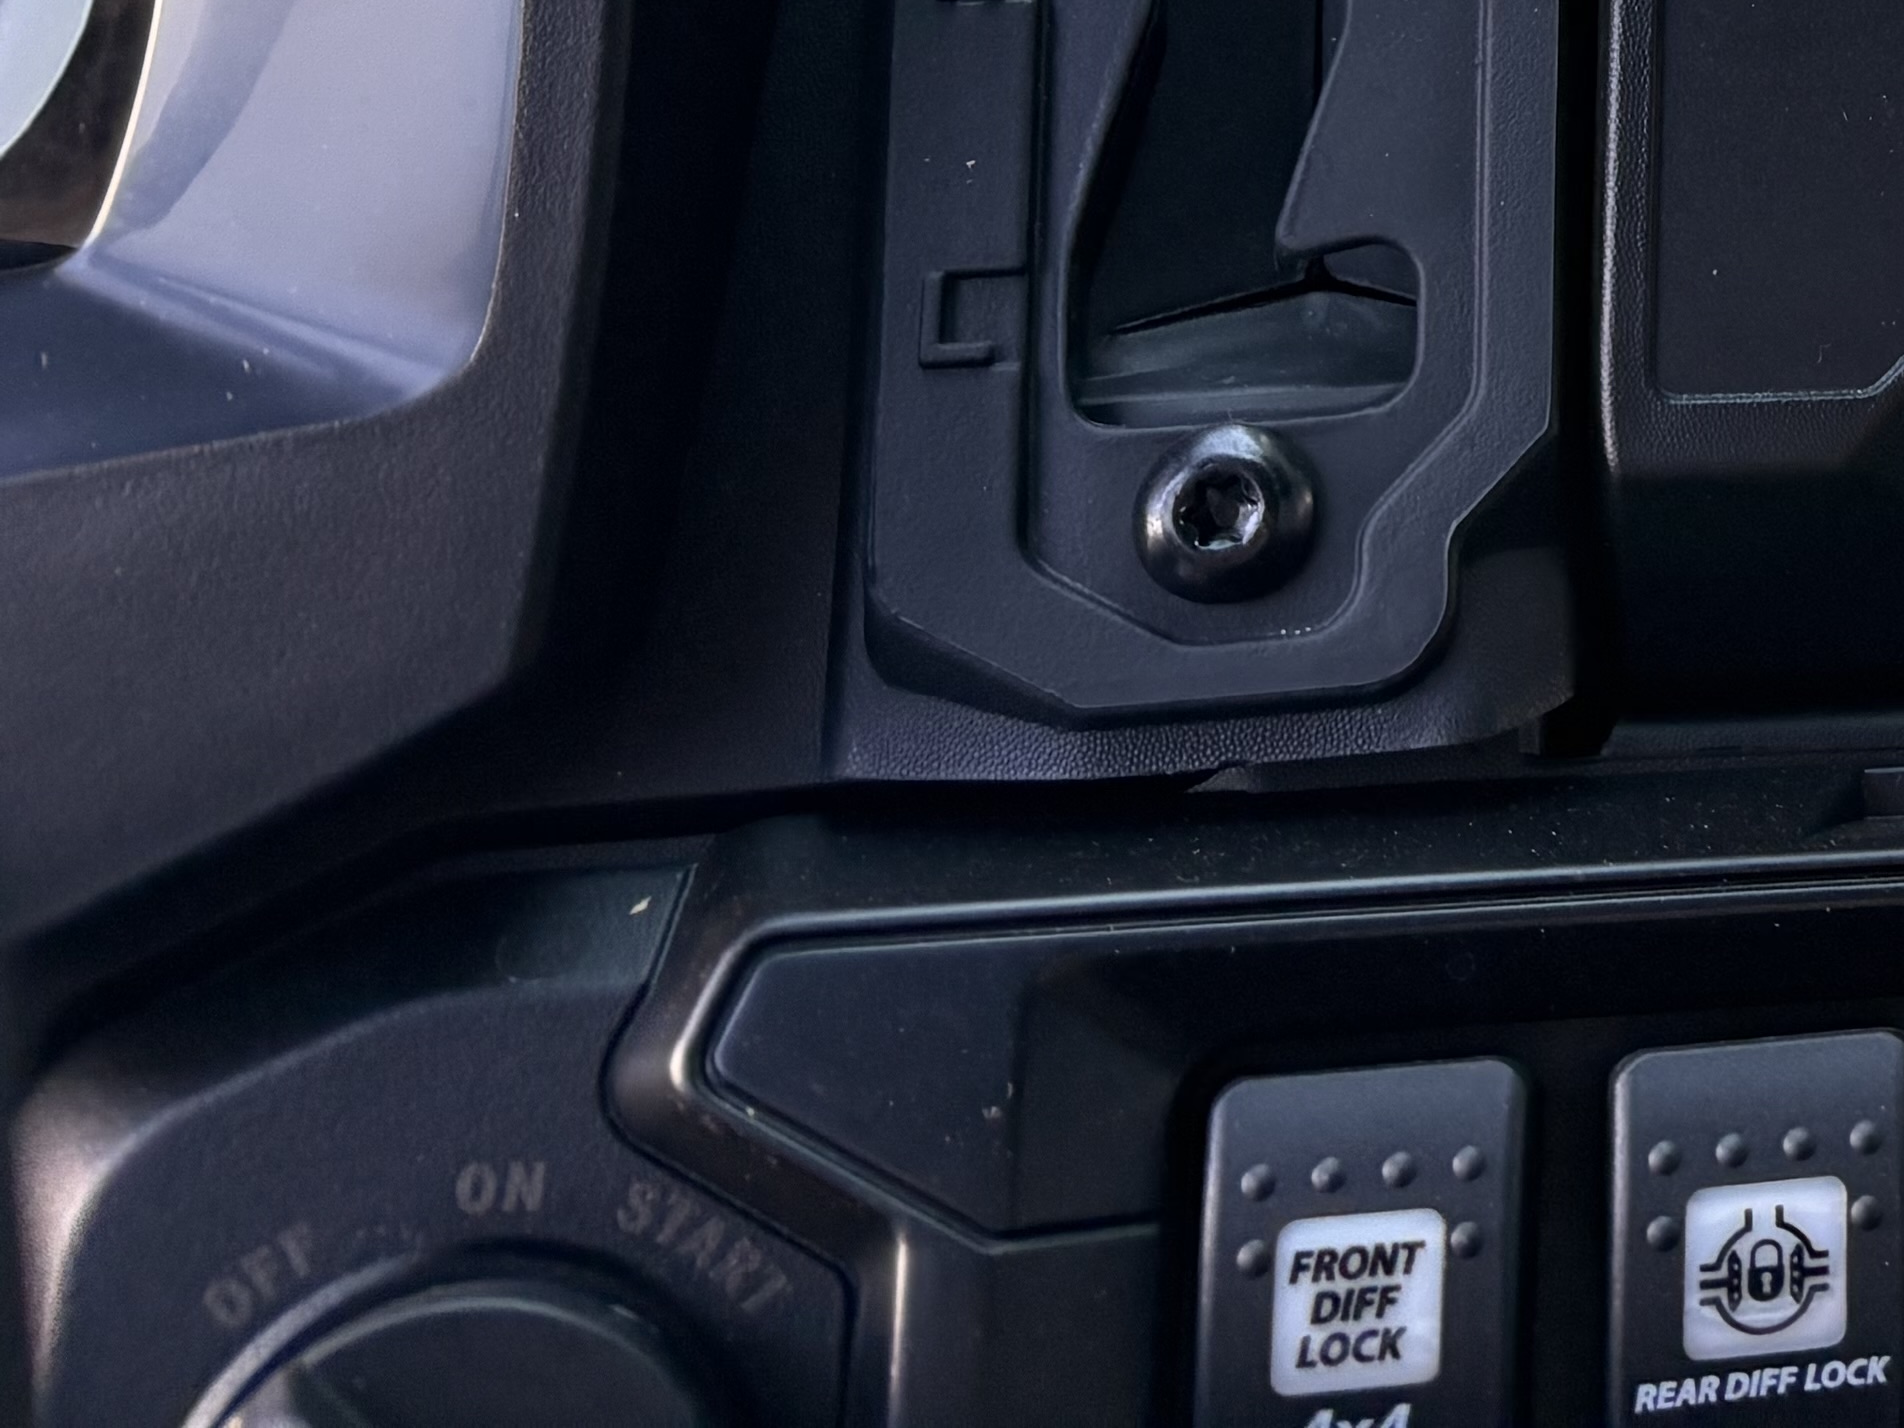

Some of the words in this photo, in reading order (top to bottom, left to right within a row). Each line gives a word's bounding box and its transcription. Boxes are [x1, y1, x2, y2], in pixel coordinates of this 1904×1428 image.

[919, 270, 997, 369] L
[454, 1160, 548, 1216] ON
[615, 1179, 796, 1314] START
[1288, 1240, 1426, 1285] FRONT
[203, 1223, 317, 1329] OFF
[1310, 1285, 1403, 1326] DIFF
[1295, 1325, 1407, 1369] LOCK
[1634, 1375, 1720, 1415] REAR
[1723, 1364, 1798, 1404] DIFF
[1799, 1355, 1892, 1397] LOCK
